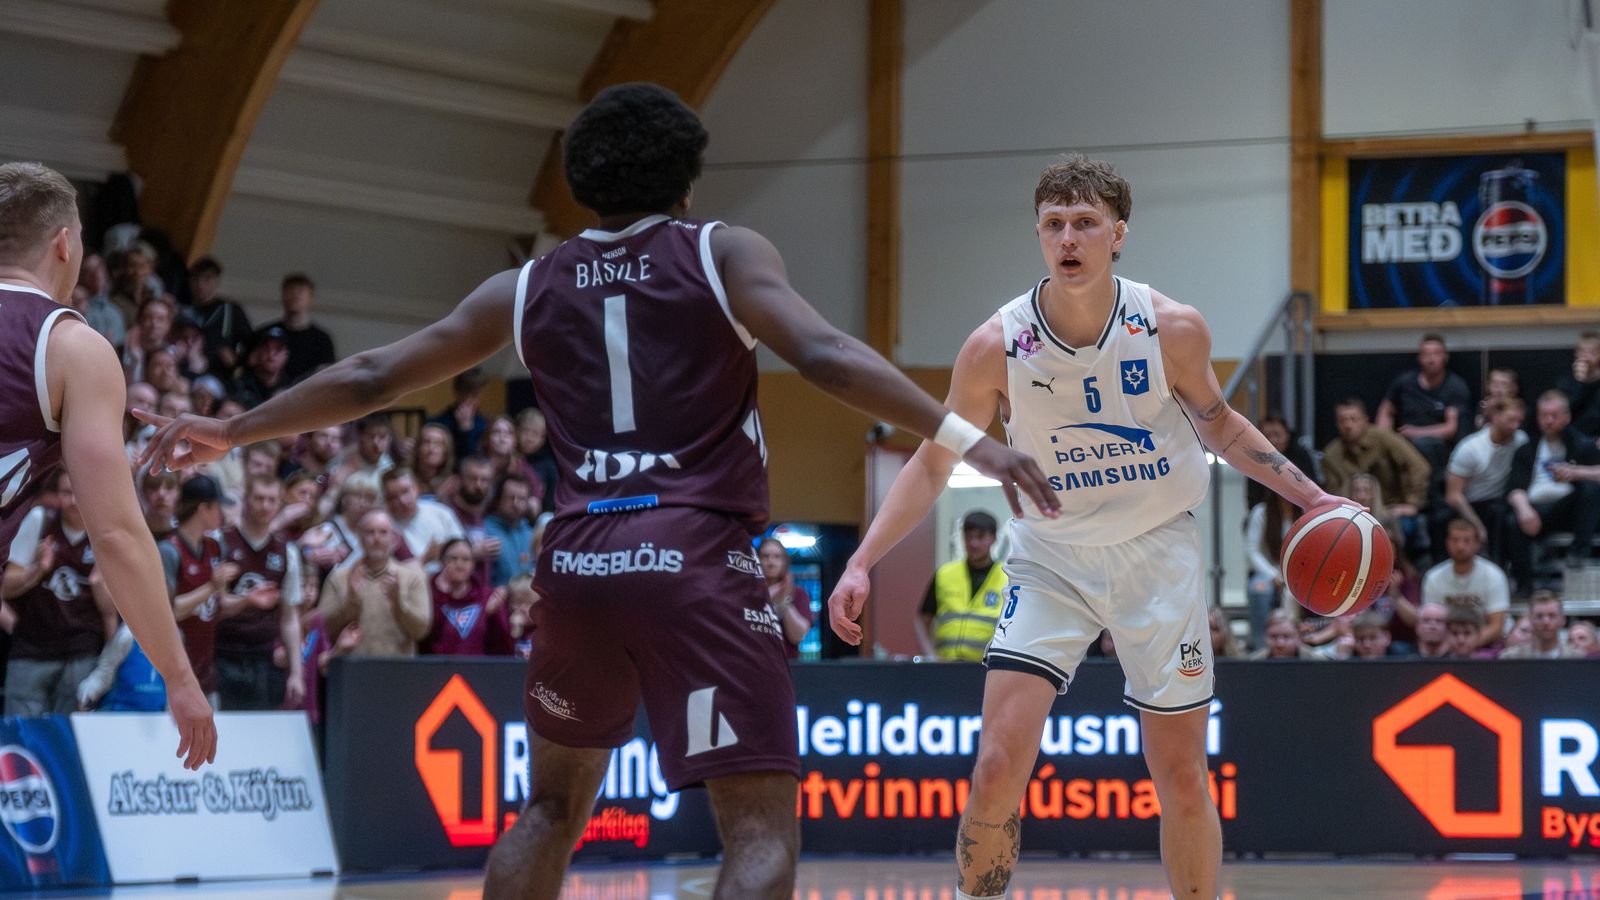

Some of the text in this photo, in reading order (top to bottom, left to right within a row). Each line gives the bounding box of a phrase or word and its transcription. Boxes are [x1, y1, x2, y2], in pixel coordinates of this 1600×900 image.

[1361, 202, 1462, 226] BETRA
[576, 254, 651, 289] BASILE
[604, 294, 637, 434] 1
[1083, 376, 1102, 413] 5
[1048, 457, 1171, 491] SAMSUNG
[1004, 585, 1021, 619] 5
[1180, 639, 1202, 660] PK
[1181, 657, 1204, 669] VERK
[109, 768, 313, 821] Akstur & Köfun
